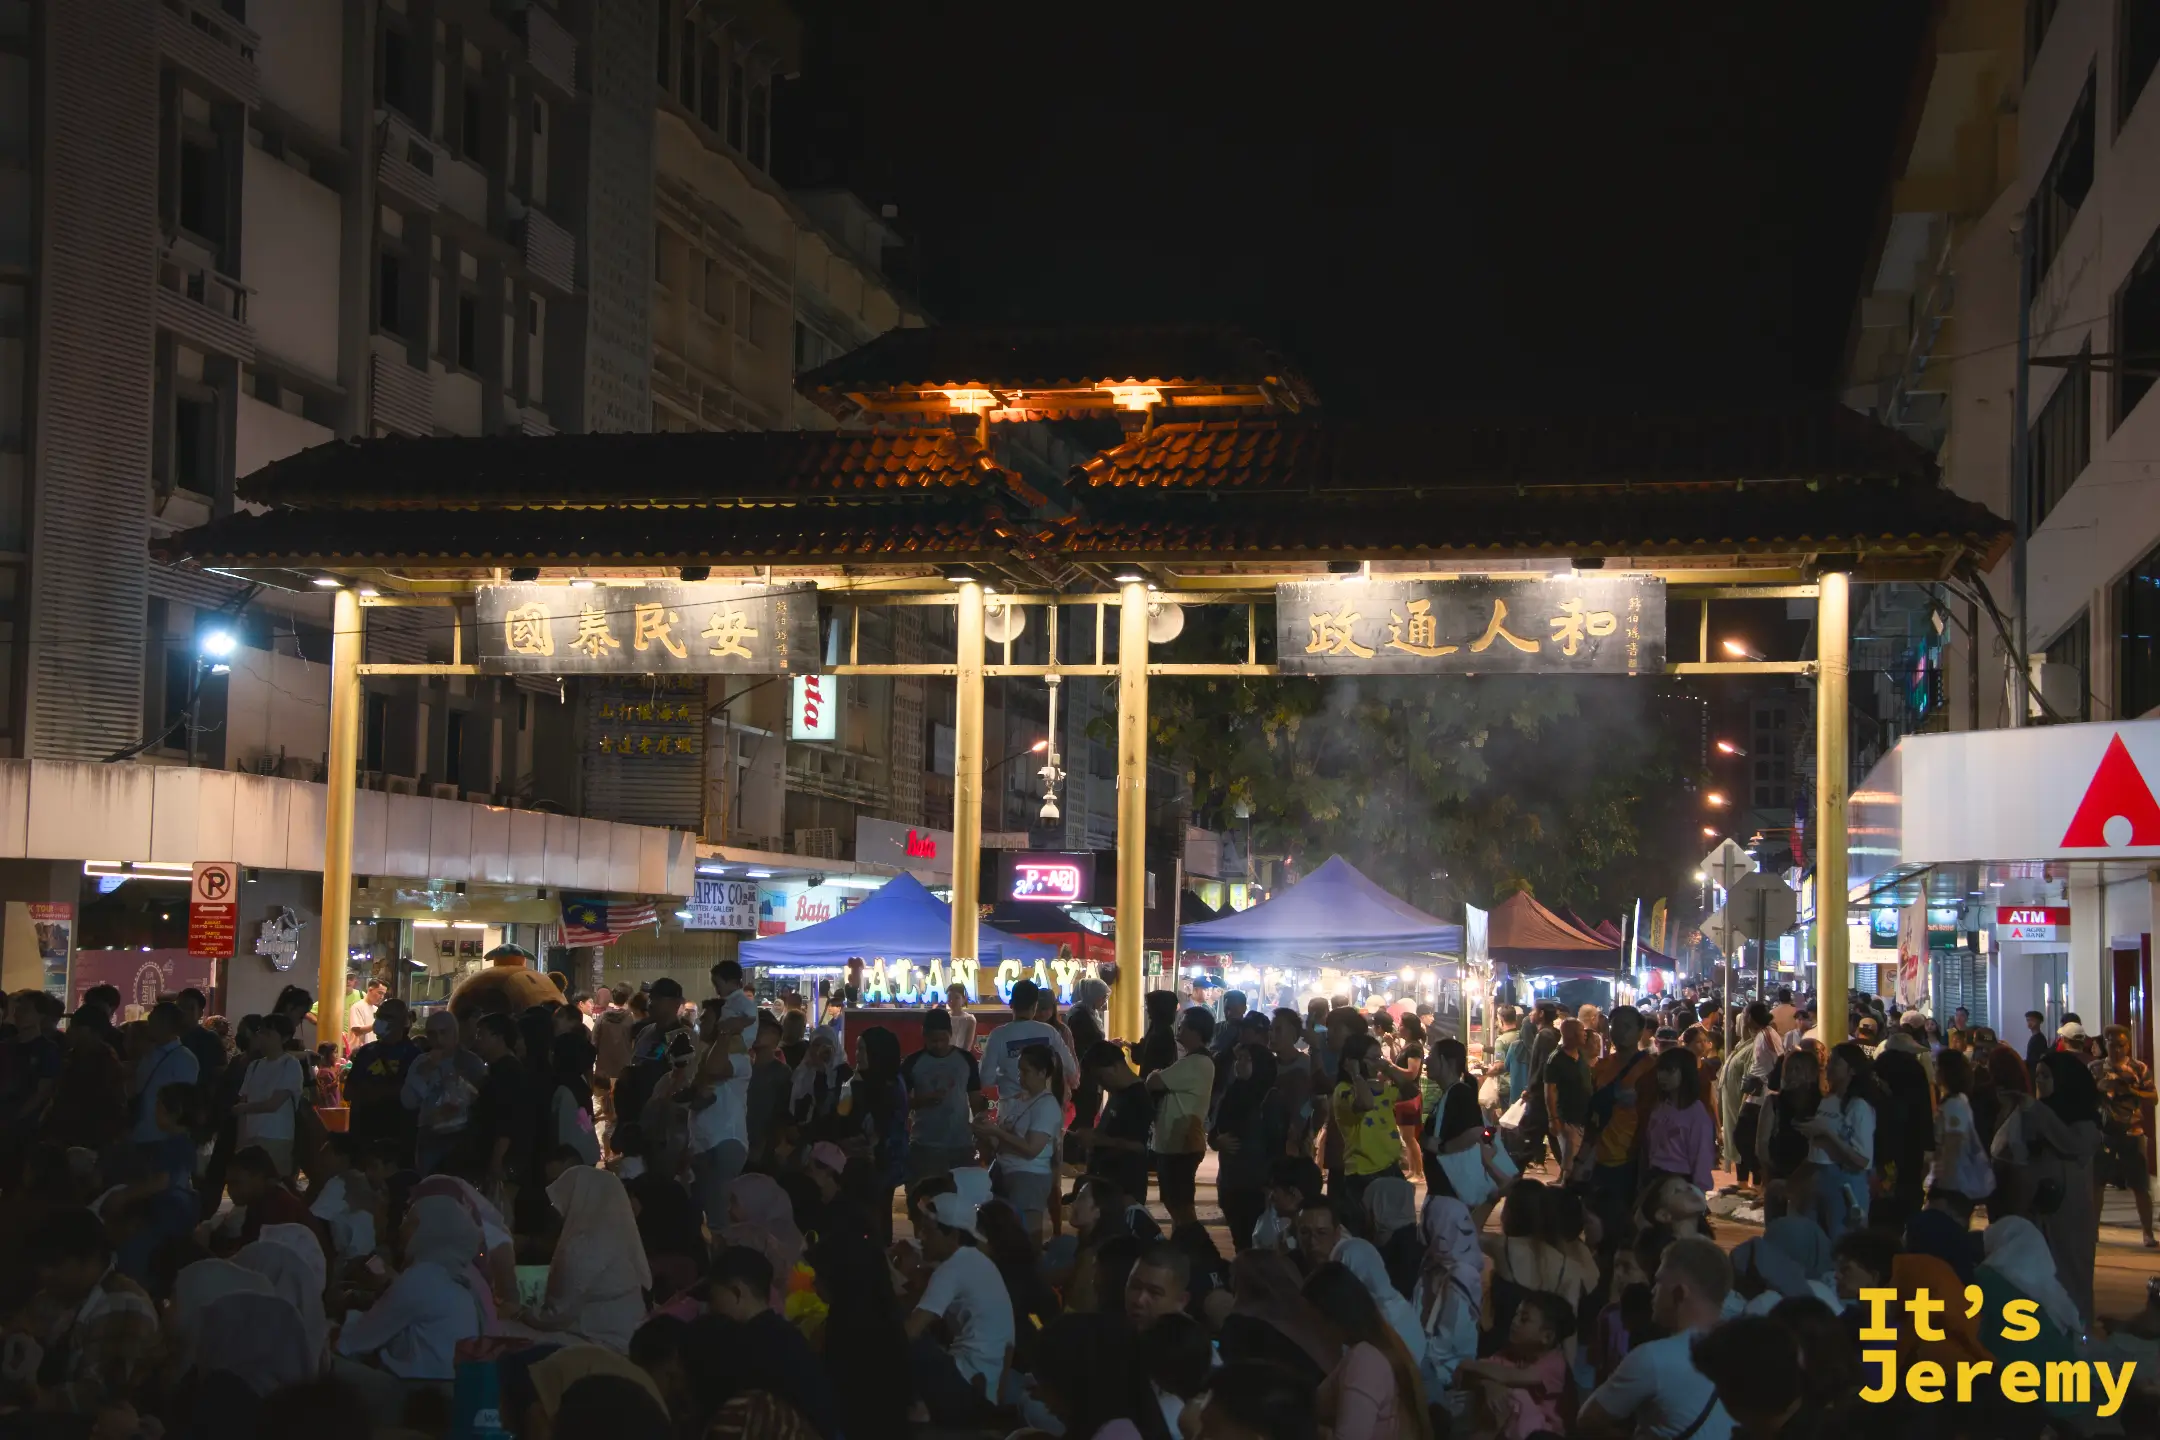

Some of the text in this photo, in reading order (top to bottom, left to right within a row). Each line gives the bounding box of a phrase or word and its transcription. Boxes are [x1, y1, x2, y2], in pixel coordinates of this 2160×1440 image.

[505, 602, 758, 659] 國泰民安
[1305, 598, 1617, 659] 政通人和
[906, 829, 937, 859] Bata
[694, 881, 724, 904] ARTS
[795, 895, 830, 922] Bata
[2009, 910, 2046, 923] ATM
